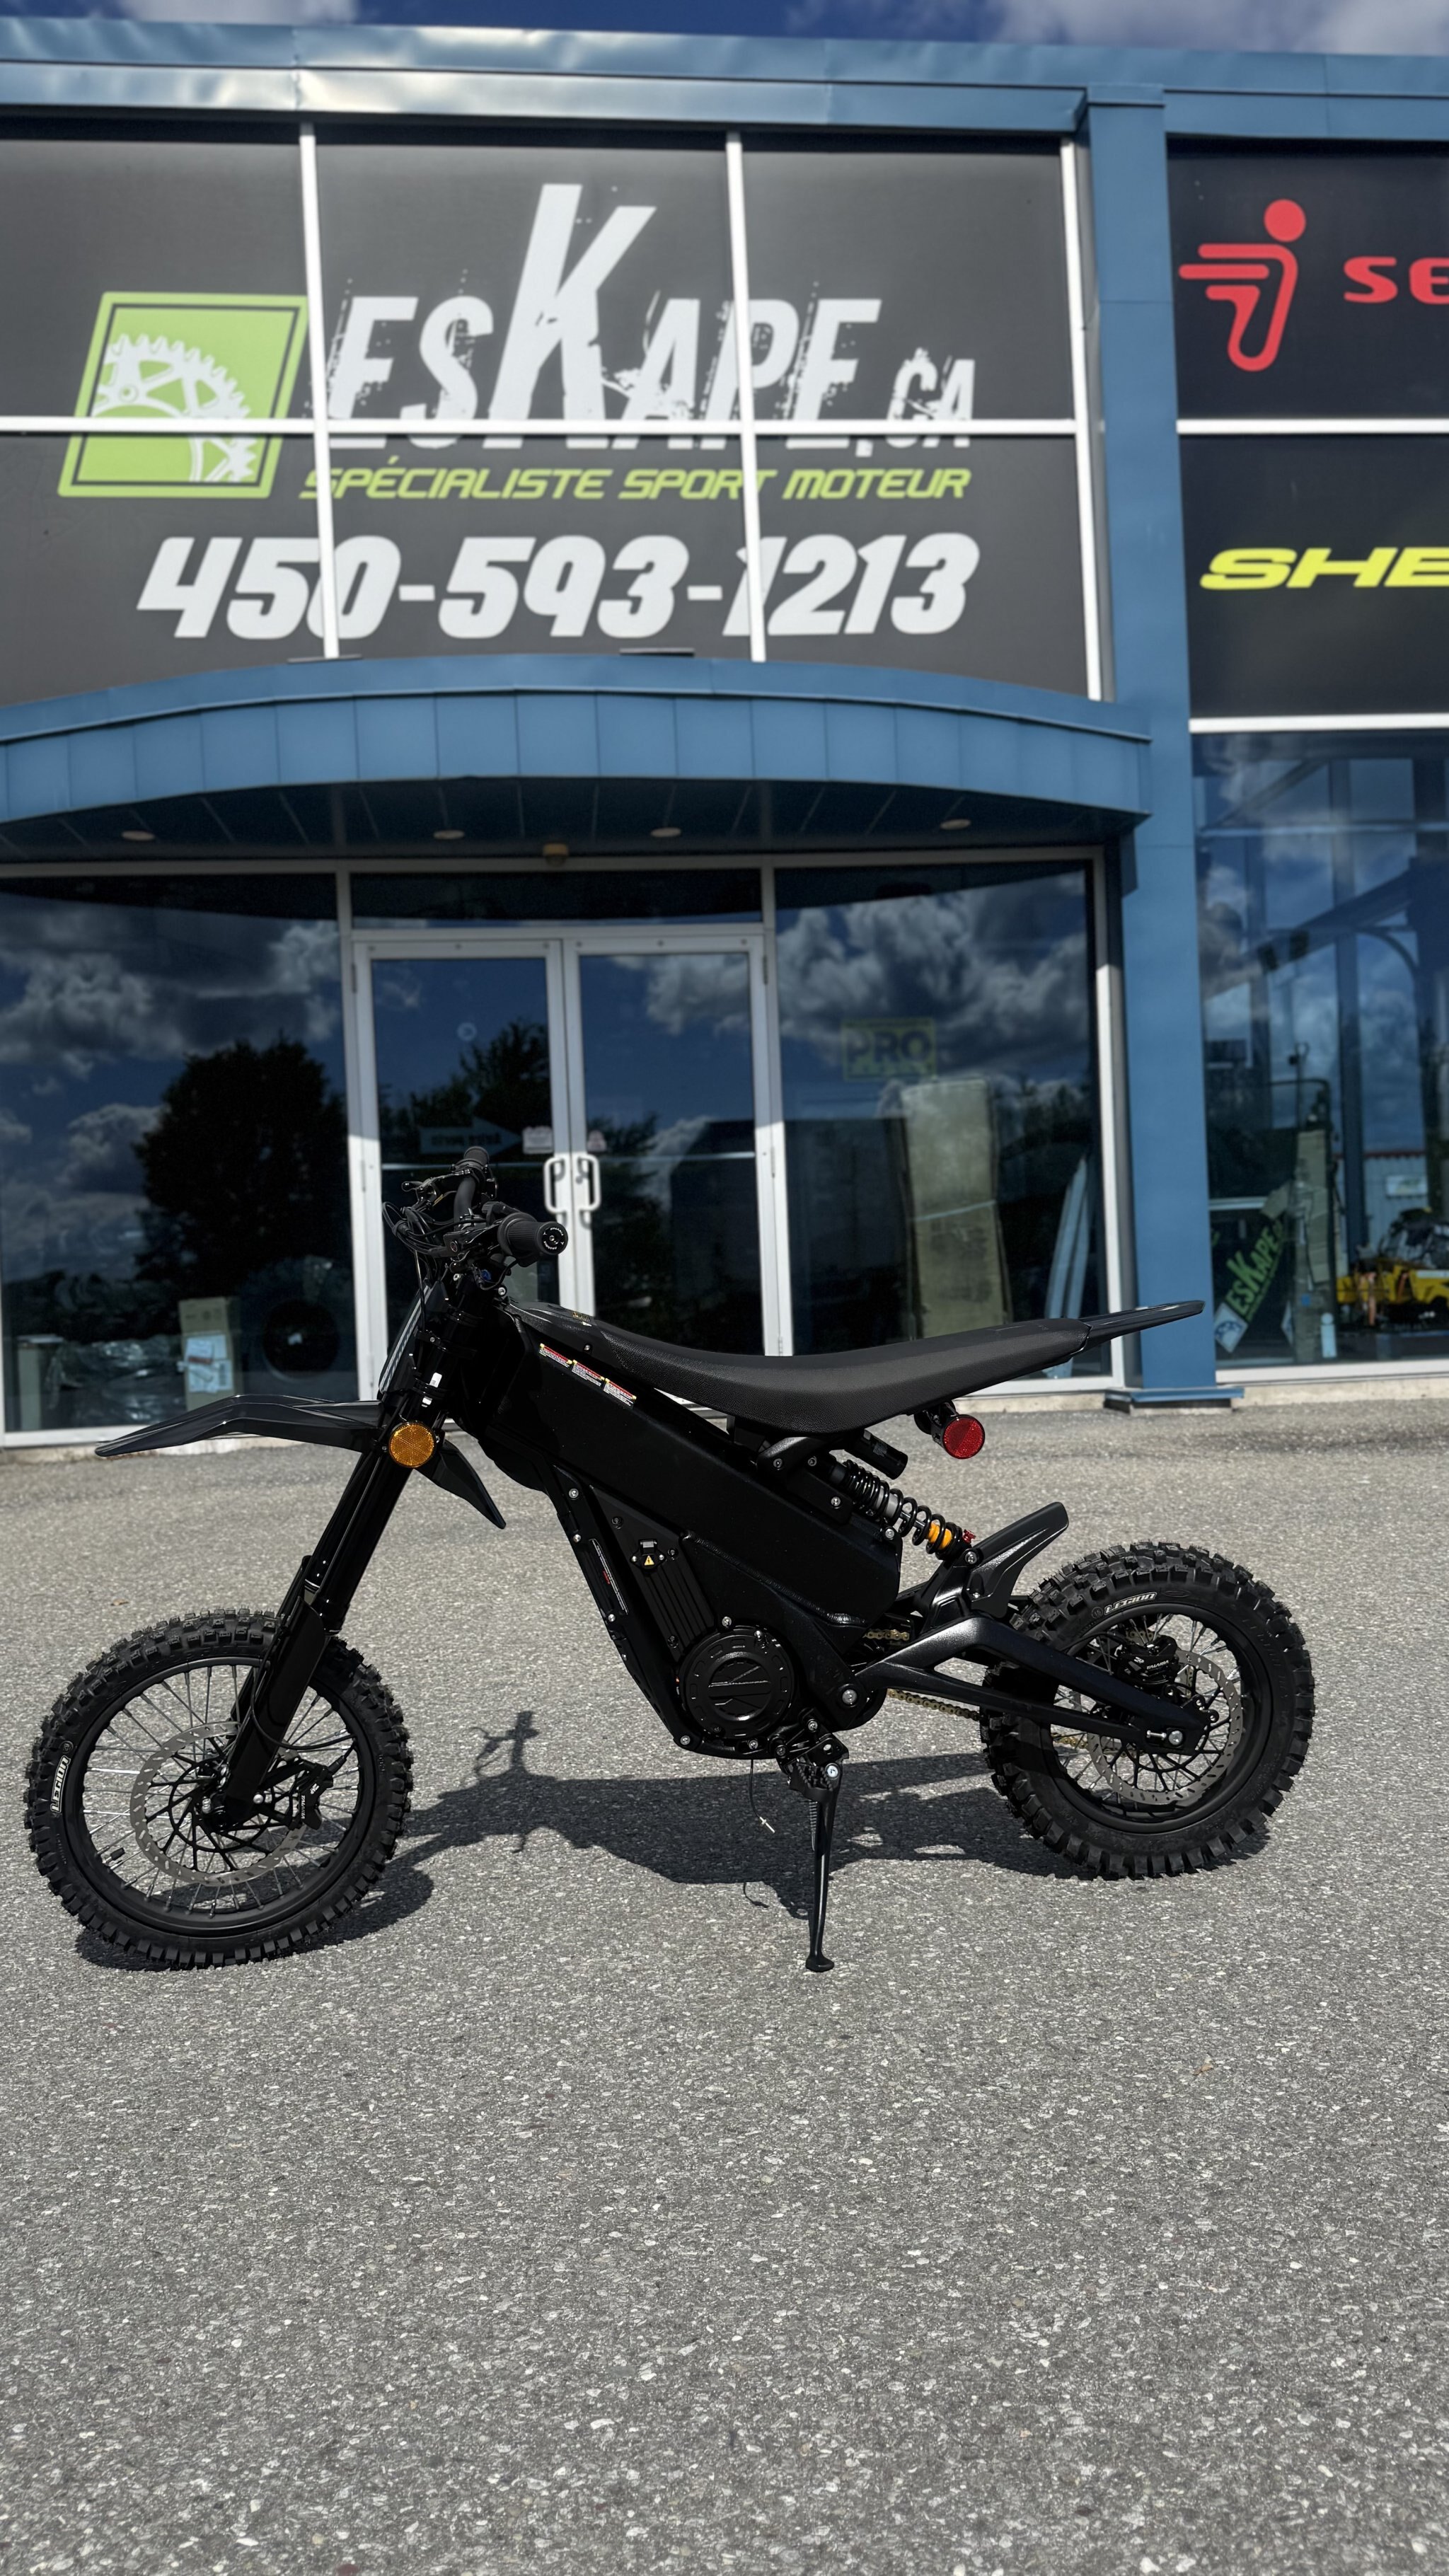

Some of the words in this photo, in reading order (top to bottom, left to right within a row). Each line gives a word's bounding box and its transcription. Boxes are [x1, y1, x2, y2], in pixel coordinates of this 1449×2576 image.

[1344, 256, 1449, 304] SE
[299, 456, 612, 499] SPÉCIALISTE
[618, 469, 777, 499] SPORT
[783, 468, 972, 499] MOTEUR
[137, 533, 981, 639] 450-593-1213
[1200, 547, 1449, 590] SHE
[847, 1029, 932, 1063] PRO
[1104, 1592, 1158, 1615] LEGION
[51, 1755, 71, 1813] LEGION
